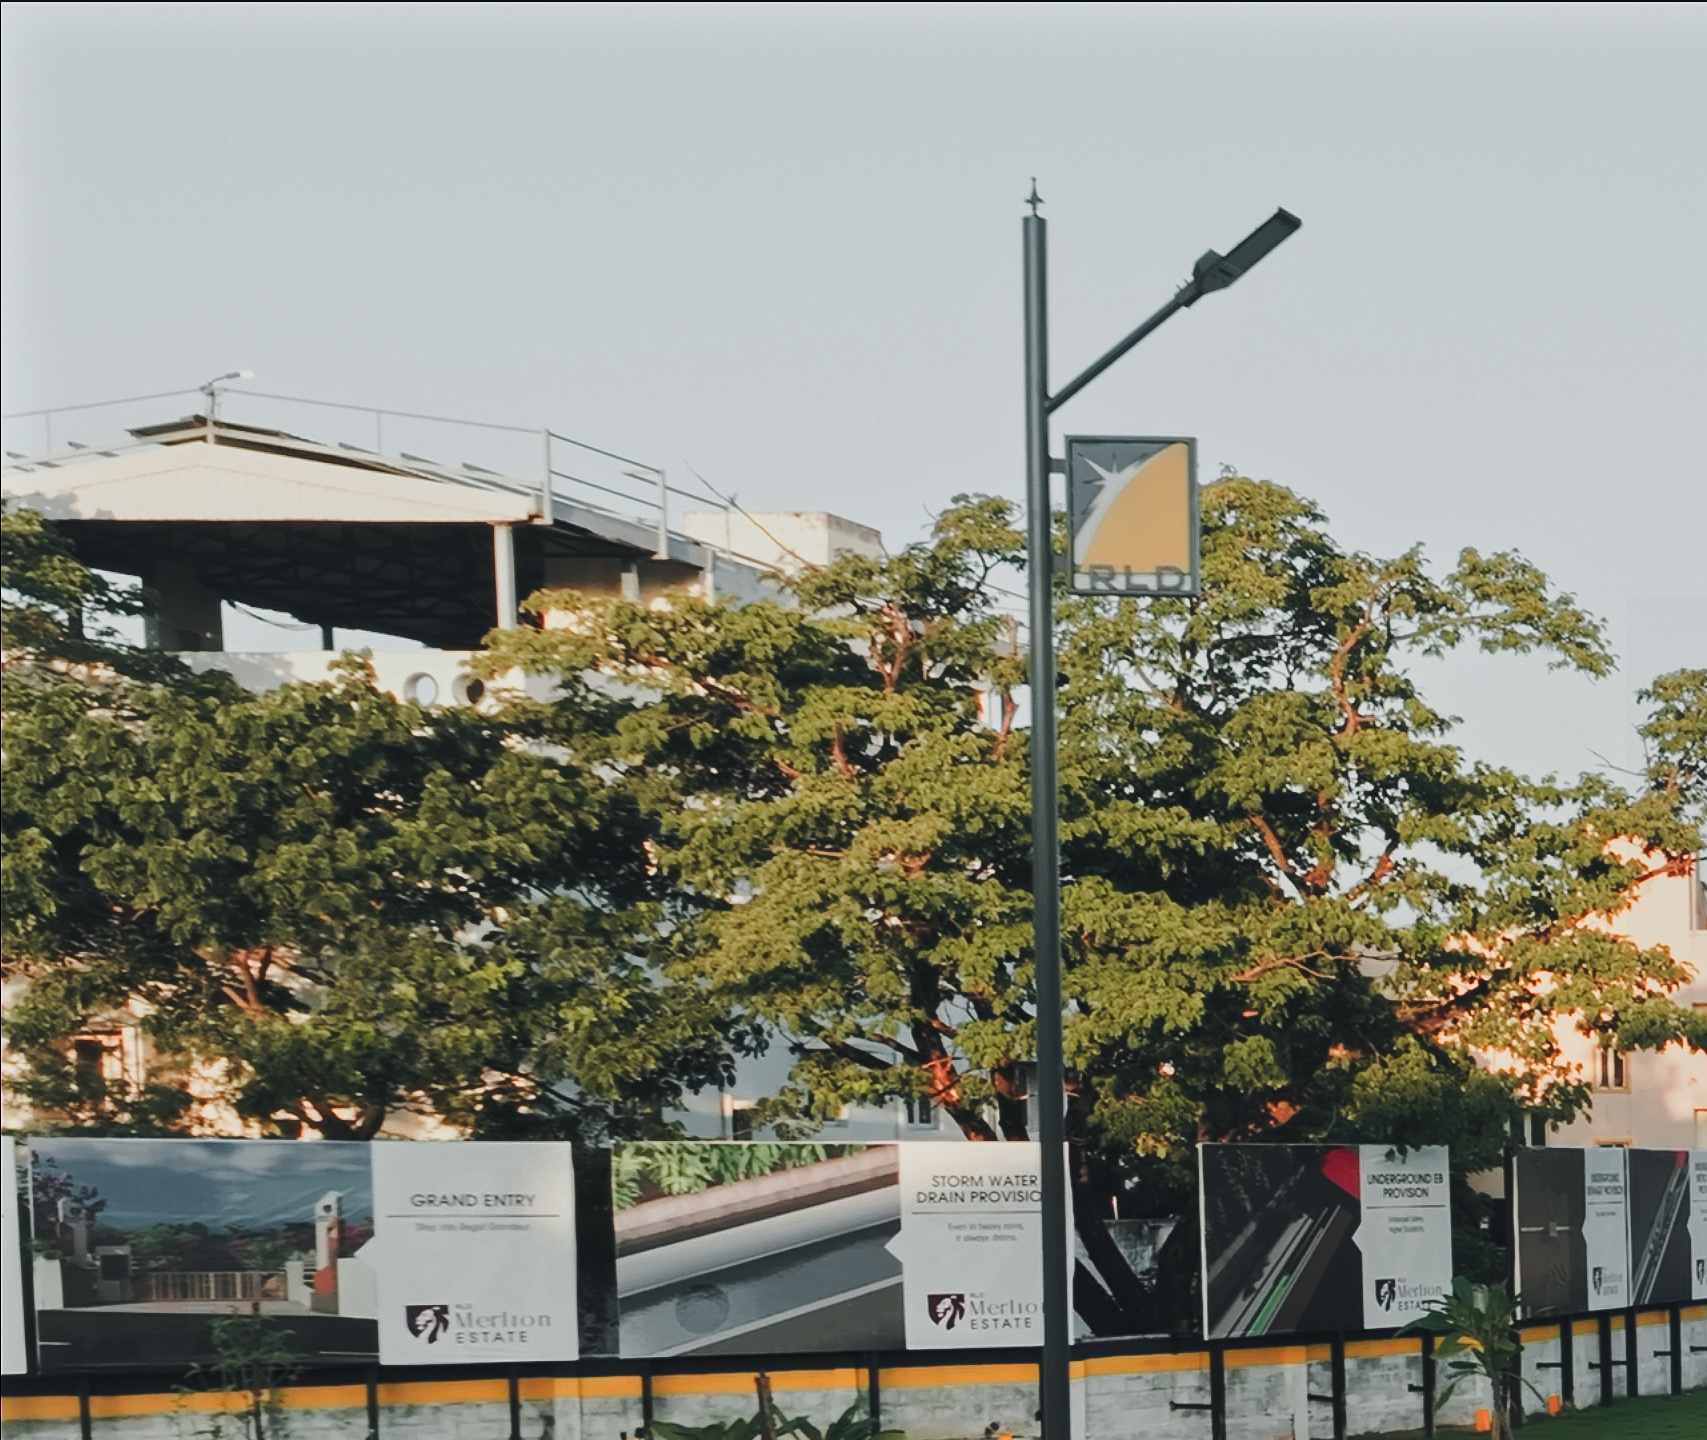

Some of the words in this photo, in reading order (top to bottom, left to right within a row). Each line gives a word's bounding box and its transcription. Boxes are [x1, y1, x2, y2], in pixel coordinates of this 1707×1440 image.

[1089, 564, 1185, 591] RLD
[932, 1175, 984, 1188] STORM
[988, 1174, 1038, 1187] WATER
[1366, 1172, 1432, 1185] UNDERGROUND
[916, 1191, 966, 1204] DRAIN
[970, 1190, 1042, 1203] PROVISIO
[1383, 1187, 1430, 1199] PROVISION
[410, 1193, 479, 1208] GRAND
[483, 1193, 537, 1207] ENTRY
[970, 1299, 1038, 1315] Merlio
[455, 1311, 552, 1329] Merlion
[970, 1317, 1032, 1330] ESTATE
[455, 1331, 529, 1344] ESTATE
